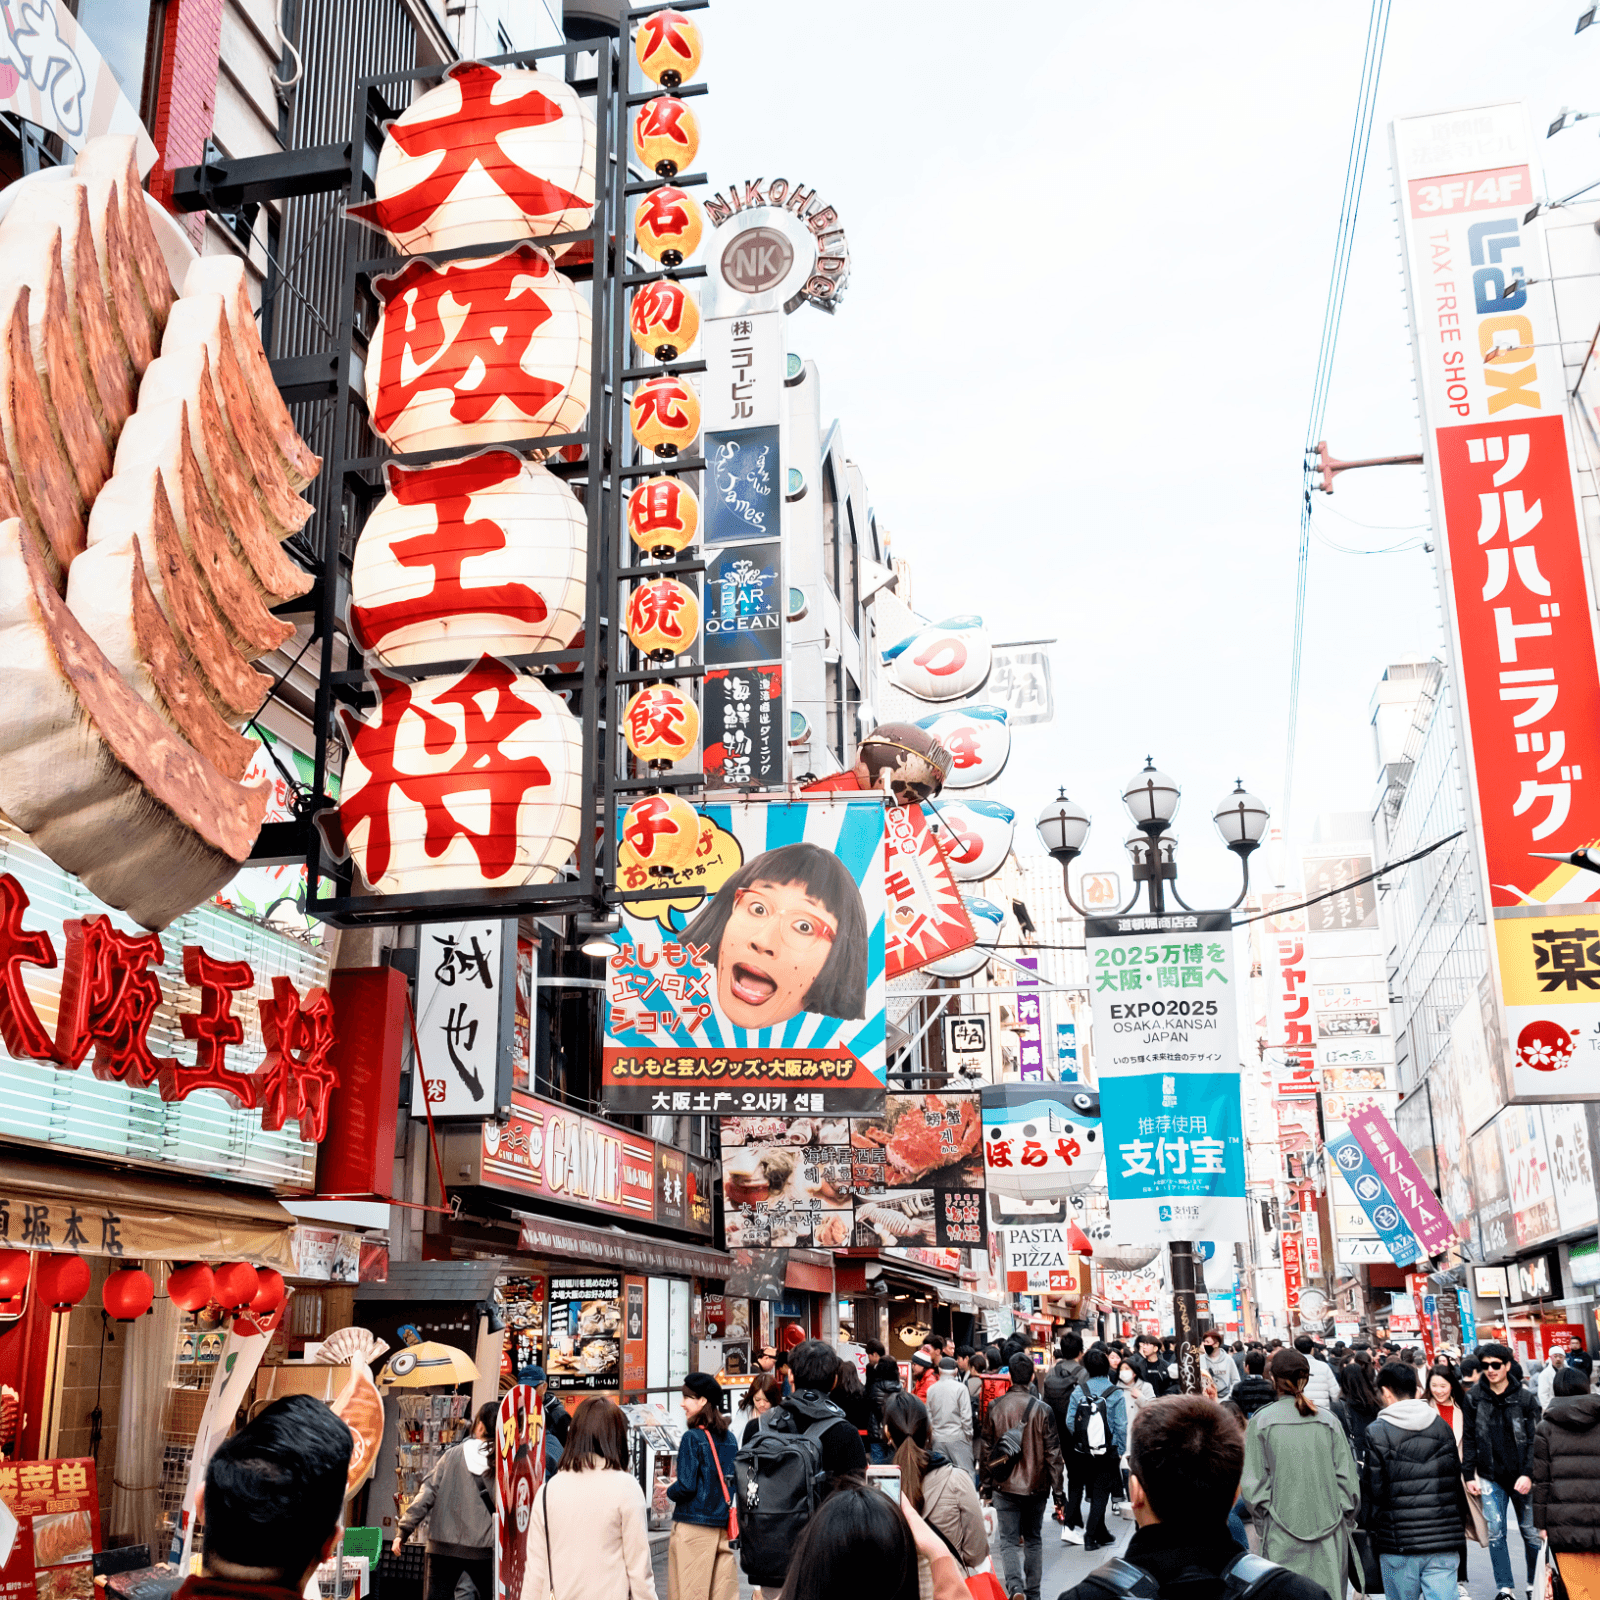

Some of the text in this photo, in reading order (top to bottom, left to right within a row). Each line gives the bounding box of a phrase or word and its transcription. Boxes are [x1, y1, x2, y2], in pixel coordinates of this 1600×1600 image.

[703, 177, 816, 228] NIKOH
[1417, 174, 1523, 213] 3F/4F
[735, 244, 779, 279] NK
[1429, 229, 1470, 417] TAX FREE SHOP
[318, 61, 594, 885] 大阪王将
[720, 472, 765, 524] James
[721, 588, 764, 606] BAR
[706, 614, 780, 633] OCEAN
[1466, 433, 1582, 842] ツルハドラッグ
[1118, 916, 1198, 932] 道頓堀商店会
[610, 942, 711, 970] よしもと
[1094, 943, 1226, 967] 2025万博を
[611, 972, 711, 1002] エンタメ
[1095, 965, 1229, 992] 大阪・関西へ
[610, 1003, 712, 1035] ショップ
[1110, 1000, 1218, 1019] EXPO2025
[1143, 1032, 1188, 1043] JAPAN
[612, 1058, 854, 1078] よしもと芸人グッズ・大阪みやげ
[1113, 1053, 1222, 1065] いのち輝く未来社会のデザイン
[793, 1093, 825, 1111] 선물
[1138, 1115, 1207, 1136] 推荐使用
[545, 1115, 623, 1207] GAME
[941, 1145, 959, 1154] かに
[1119, 1136, 1226, 1178] 支付宝
[1382, 1151, 1436, 1226] ZAZA
[1009, 1228, 1064, 1244] PASTA
[1012, 1252, 1065, 1267] PIZZA
[551, 1289, 619, 1299] 本場大阪のお好み焼き
[552, 1279, 619, 1288] 道頓堀川を眺めながら
